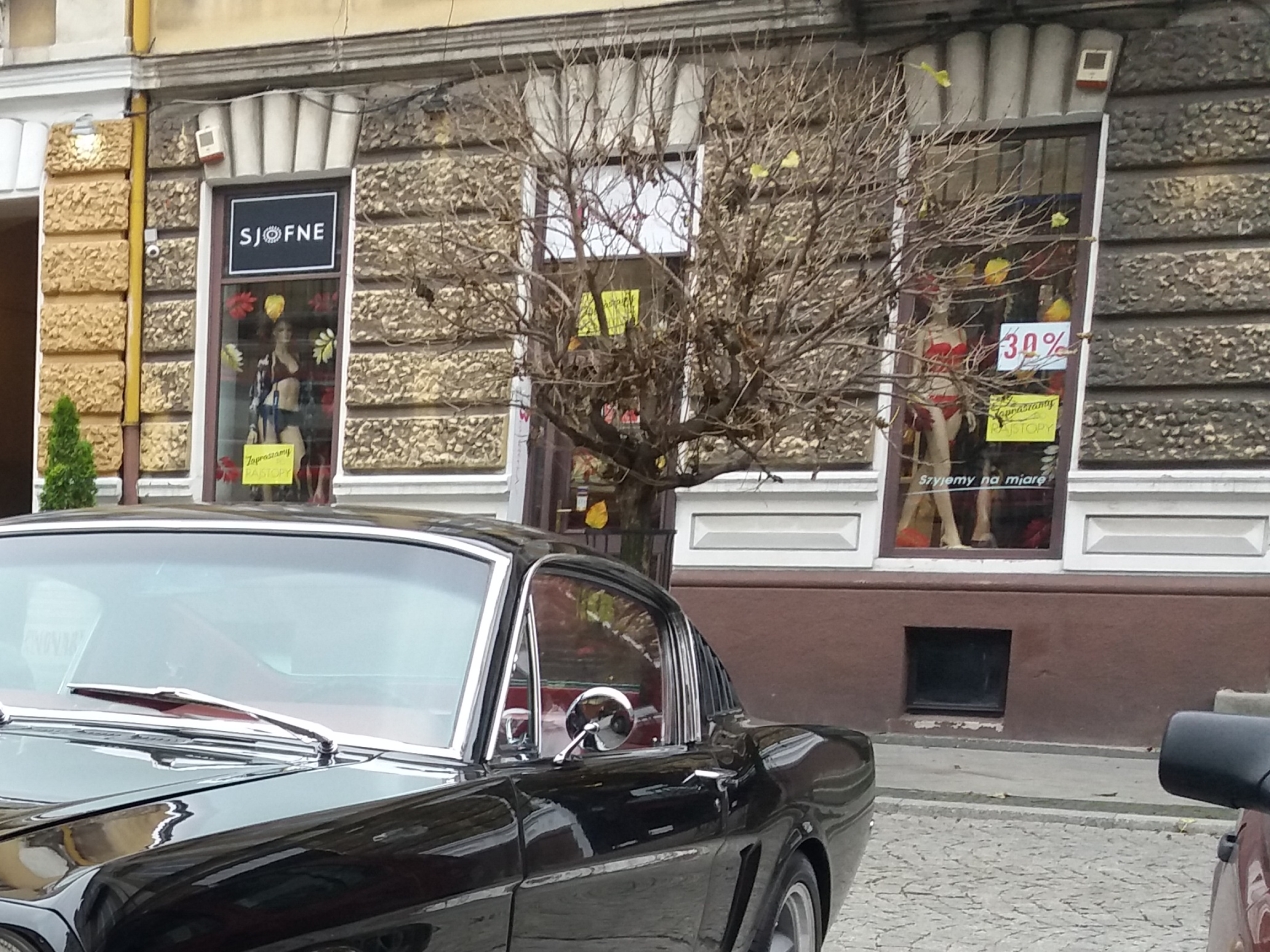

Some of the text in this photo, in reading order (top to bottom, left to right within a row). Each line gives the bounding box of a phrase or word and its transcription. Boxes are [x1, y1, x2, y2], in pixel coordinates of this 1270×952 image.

[245, 448, 291, 466] Zapraszamy
[919, 474, 976, 486] Szyjemy
[981, 475, 1000, 485] na
